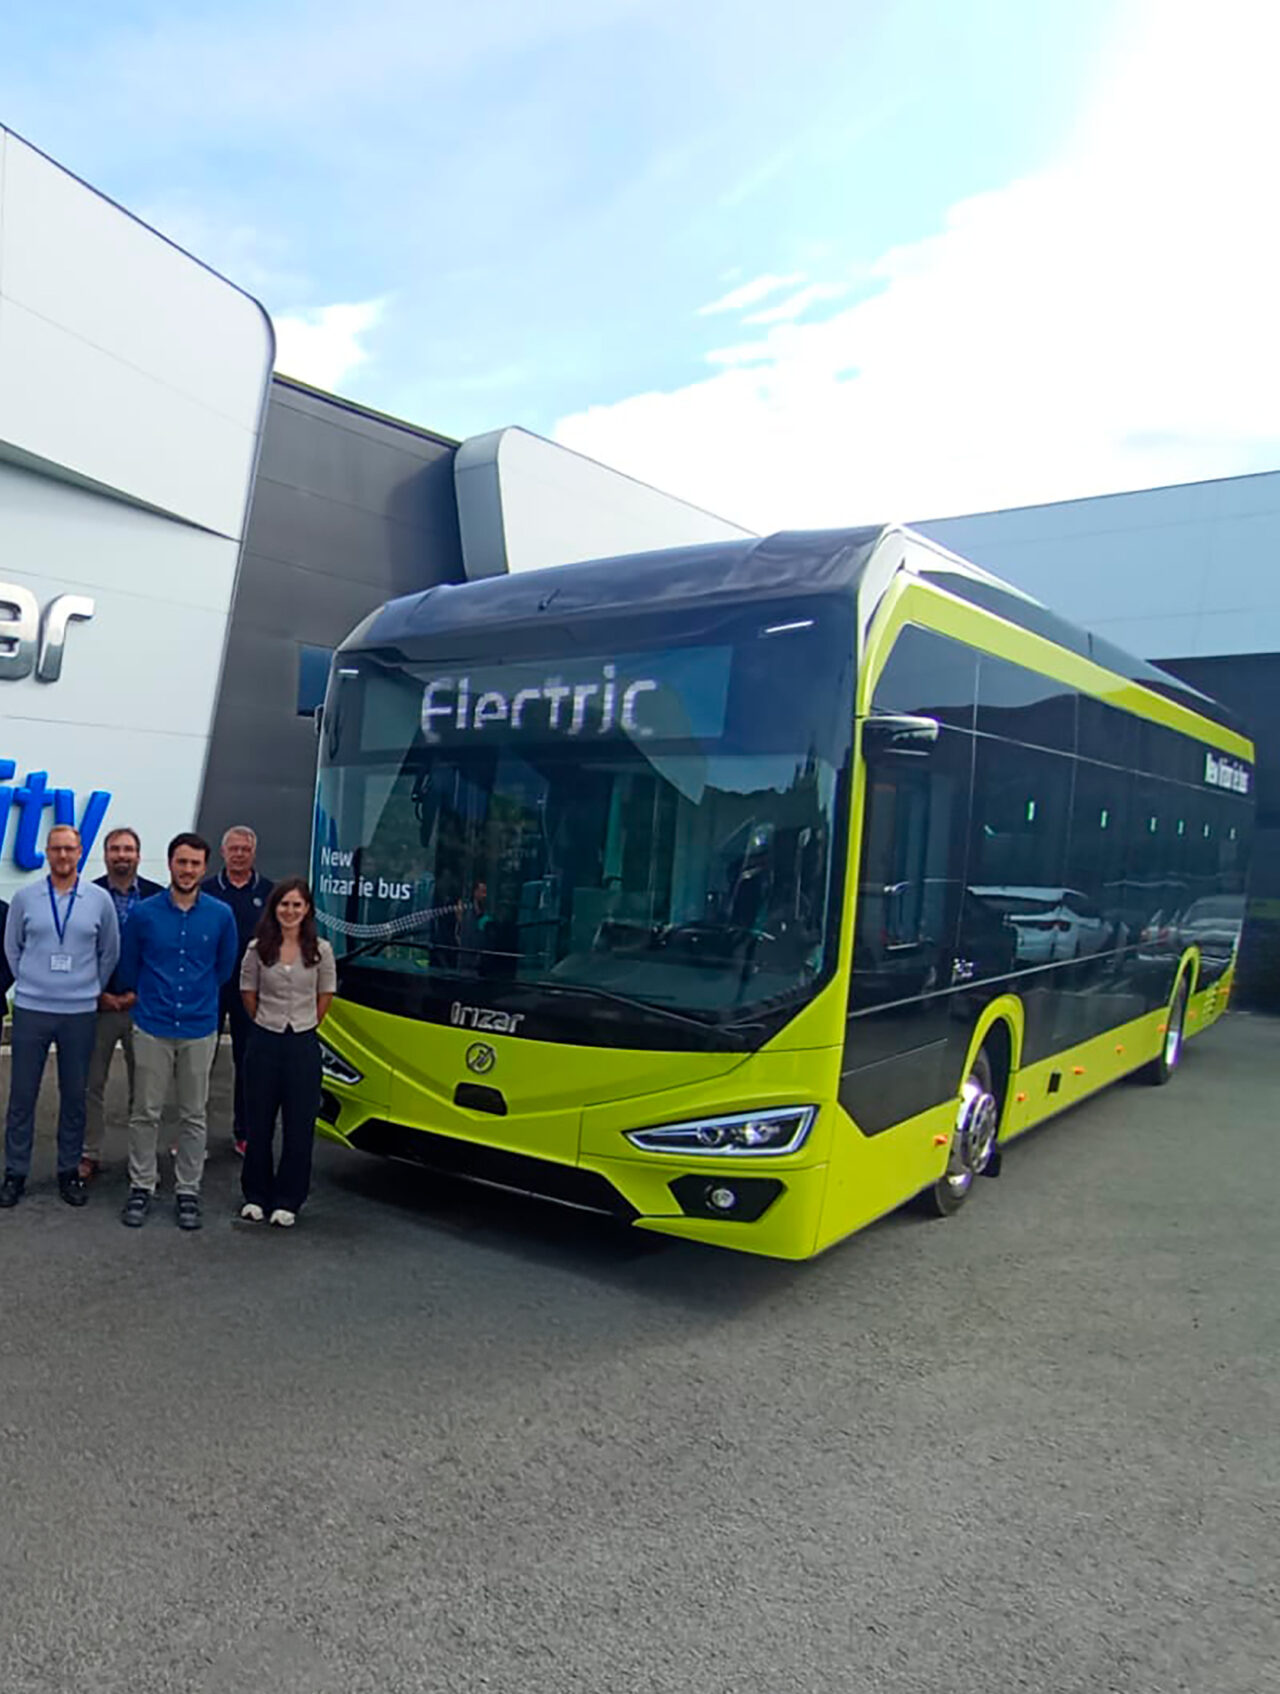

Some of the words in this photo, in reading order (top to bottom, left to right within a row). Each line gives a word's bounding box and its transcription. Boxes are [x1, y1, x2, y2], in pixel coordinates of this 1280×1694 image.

[321, 846, 353, 867] New
[320, 874, 355, 896] Irizar
[358, 875, 373, 897] ie
[378, 877, 411, 899] bus
[451, 1001, 525, 1033] Irizar
